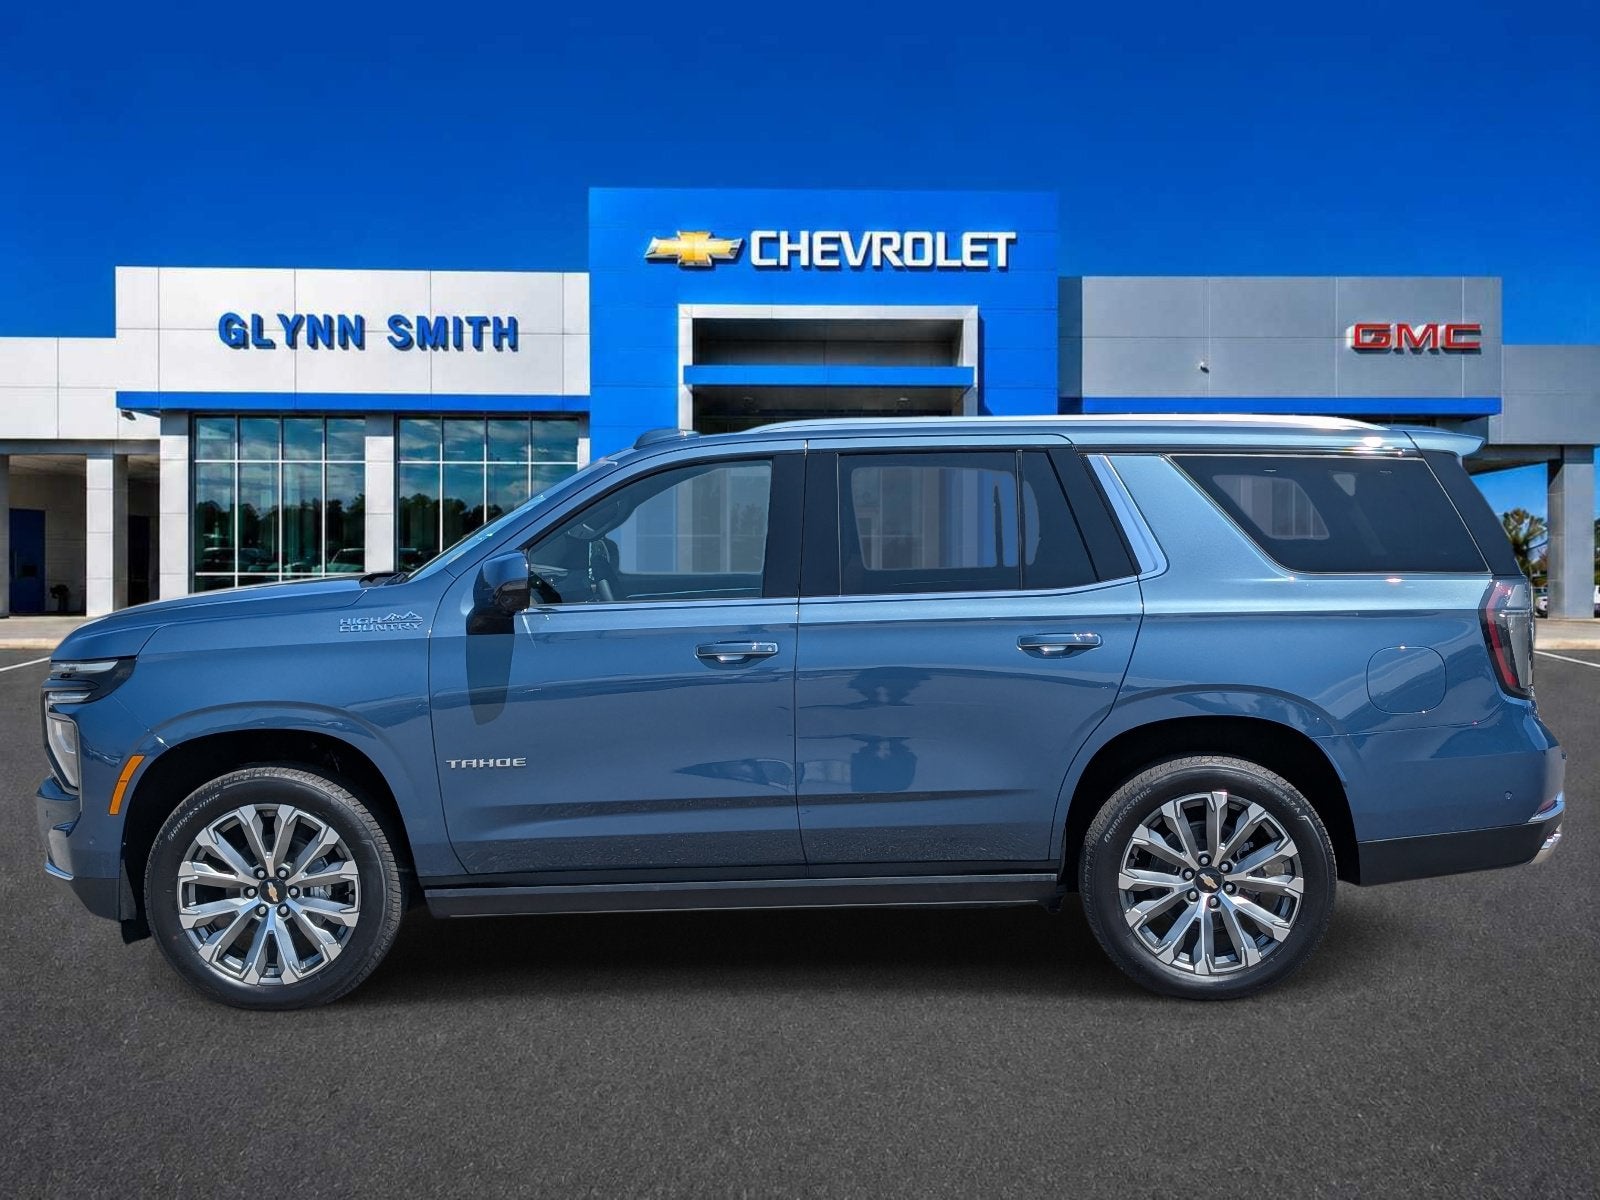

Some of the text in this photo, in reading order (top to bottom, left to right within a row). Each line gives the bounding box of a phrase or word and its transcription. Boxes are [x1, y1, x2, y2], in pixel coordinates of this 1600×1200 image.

[750, 230, 1017, 269] CHEVROLET
[218, 312, 519, 351] GLYNN SMITH
[1346, 323, 1482, 352] GMC
[339, 617, 382, 625] HIGH
[339, 622, 423, 633] COUNTRY
[446, 757, 527, 769] TAHOE
